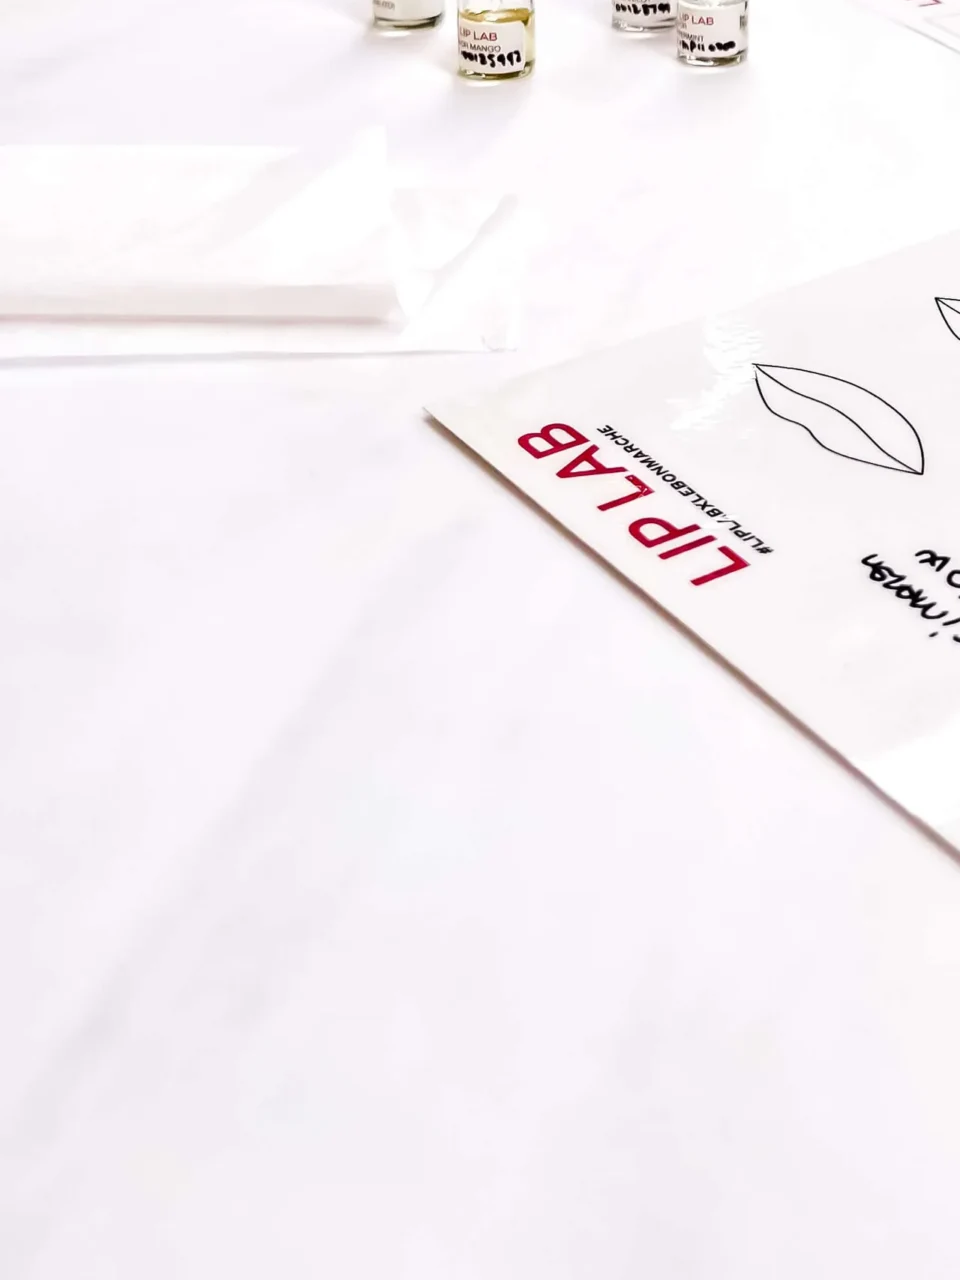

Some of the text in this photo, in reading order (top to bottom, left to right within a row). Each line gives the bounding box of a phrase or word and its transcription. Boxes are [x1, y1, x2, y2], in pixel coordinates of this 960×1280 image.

[691, 15, 714, 25] LAB
[473, 30, 498, 42] LAB
[469, 42, 502, 53] MANGO
[517, 422, 751, 586] LIP LAB
